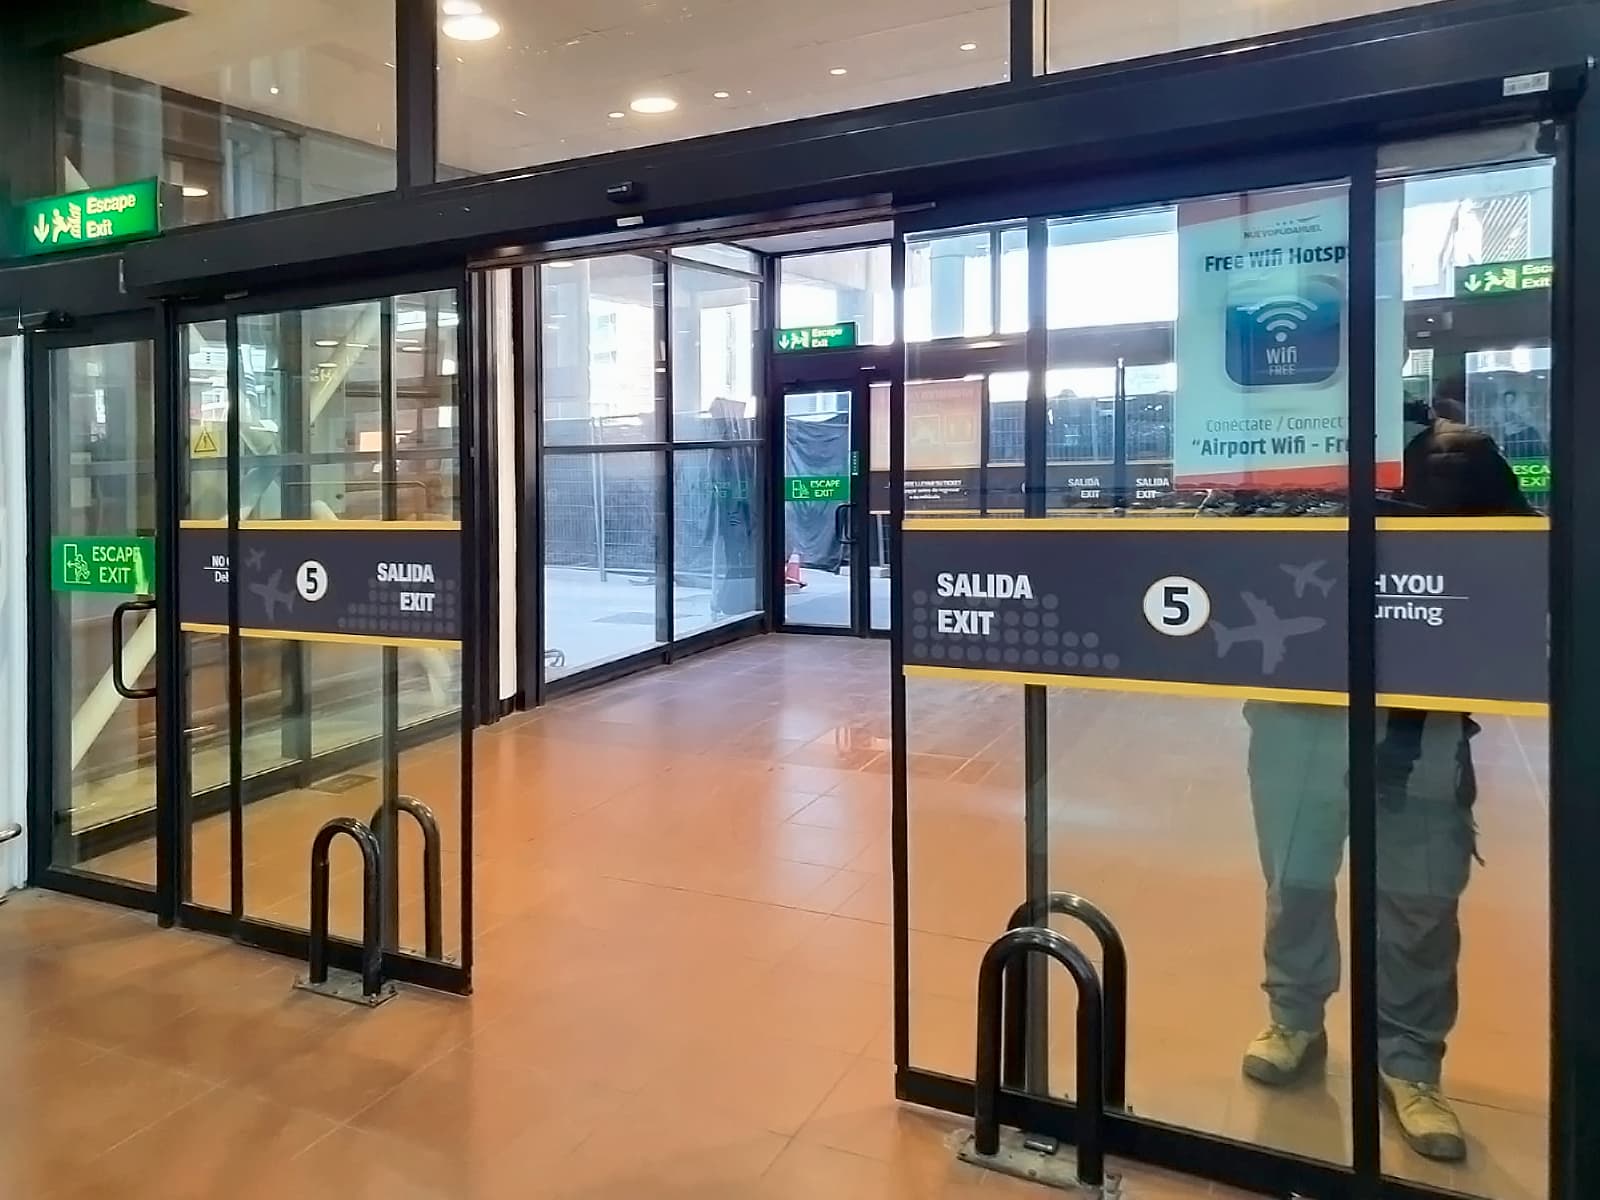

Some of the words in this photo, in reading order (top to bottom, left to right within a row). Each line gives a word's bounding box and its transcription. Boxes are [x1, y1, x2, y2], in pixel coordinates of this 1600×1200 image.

[86, 194, 136, 214] Escape
[86, 218, 113, 238] Exit
[1205, 255, 1244, 272] Free
[1248, 247, 1284, 268] Wifi
[1289, 244, 1349, 265] Hotsp
[1266, 346, 1298, 364] Wifi
[1268, 364, 1297, 376] FREE
[1287, 415, 1345, 431] Connect
[1271, 434, 1306, 455] Wifi
[810, 480, 841, 489] ESCAPE
[1068, 478, 1100, 487] SALIDA
[1135, 478, 1170, 487] SALIDA
[815, 488, 834, 498] EXIT
[1080, 490, 1100, 499] EXIT
[1135, 490, 1157, 499] EXIT
[92, 546, 141, 563] ESCAPE
[211, 555, 226, 568] NO
[99, 567, 131, 584] EXIT
[306, 568, 318, 594] 5
[376, 562, 435, 583] SALIDA
[937, 572, 1033, 600] SALIDA
[1391, 574, 1444, 594] YOU
[400, 592, 436, 612] EXIT
[1162, 586, 1190, 626] 5
[938, 609, 994, 636] EXIT
